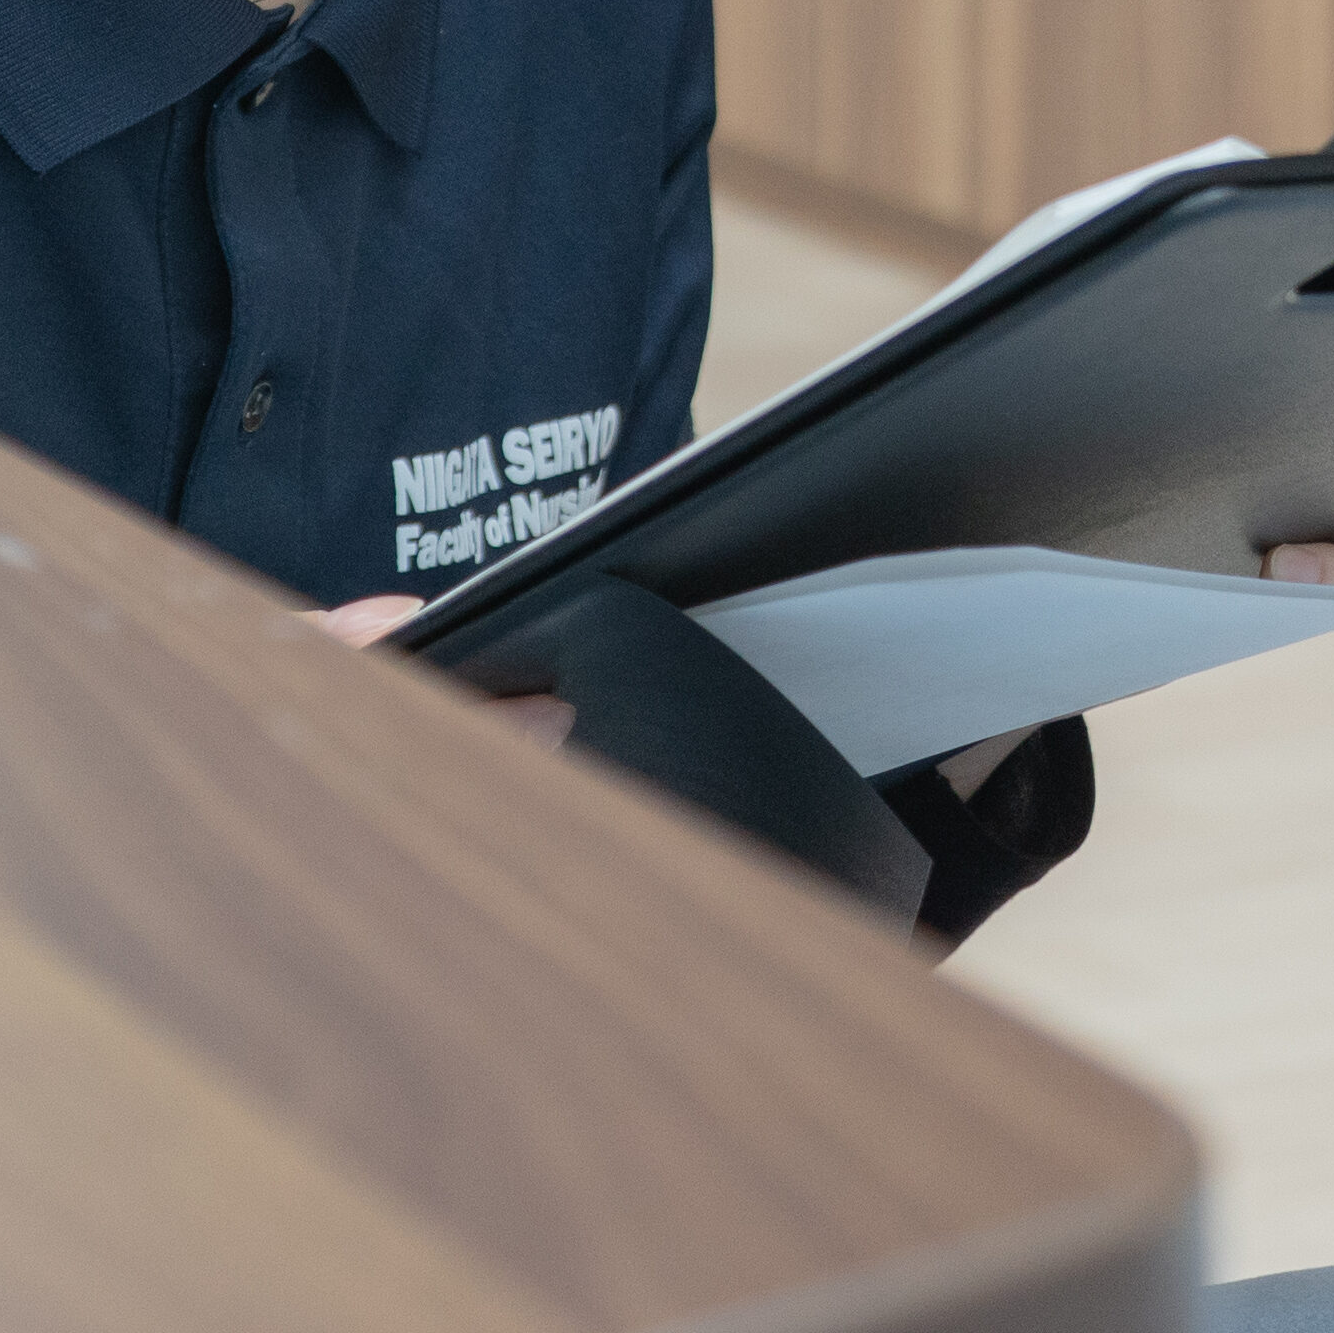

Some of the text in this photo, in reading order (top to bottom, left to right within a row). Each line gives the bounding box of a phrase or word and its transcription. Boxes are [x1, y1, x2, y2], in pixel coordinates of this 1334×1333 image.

[501, 403, 620, 485] SEIRYO
[395, 509, 484, 573] Faculty
[484, 503, 514, 548] of
